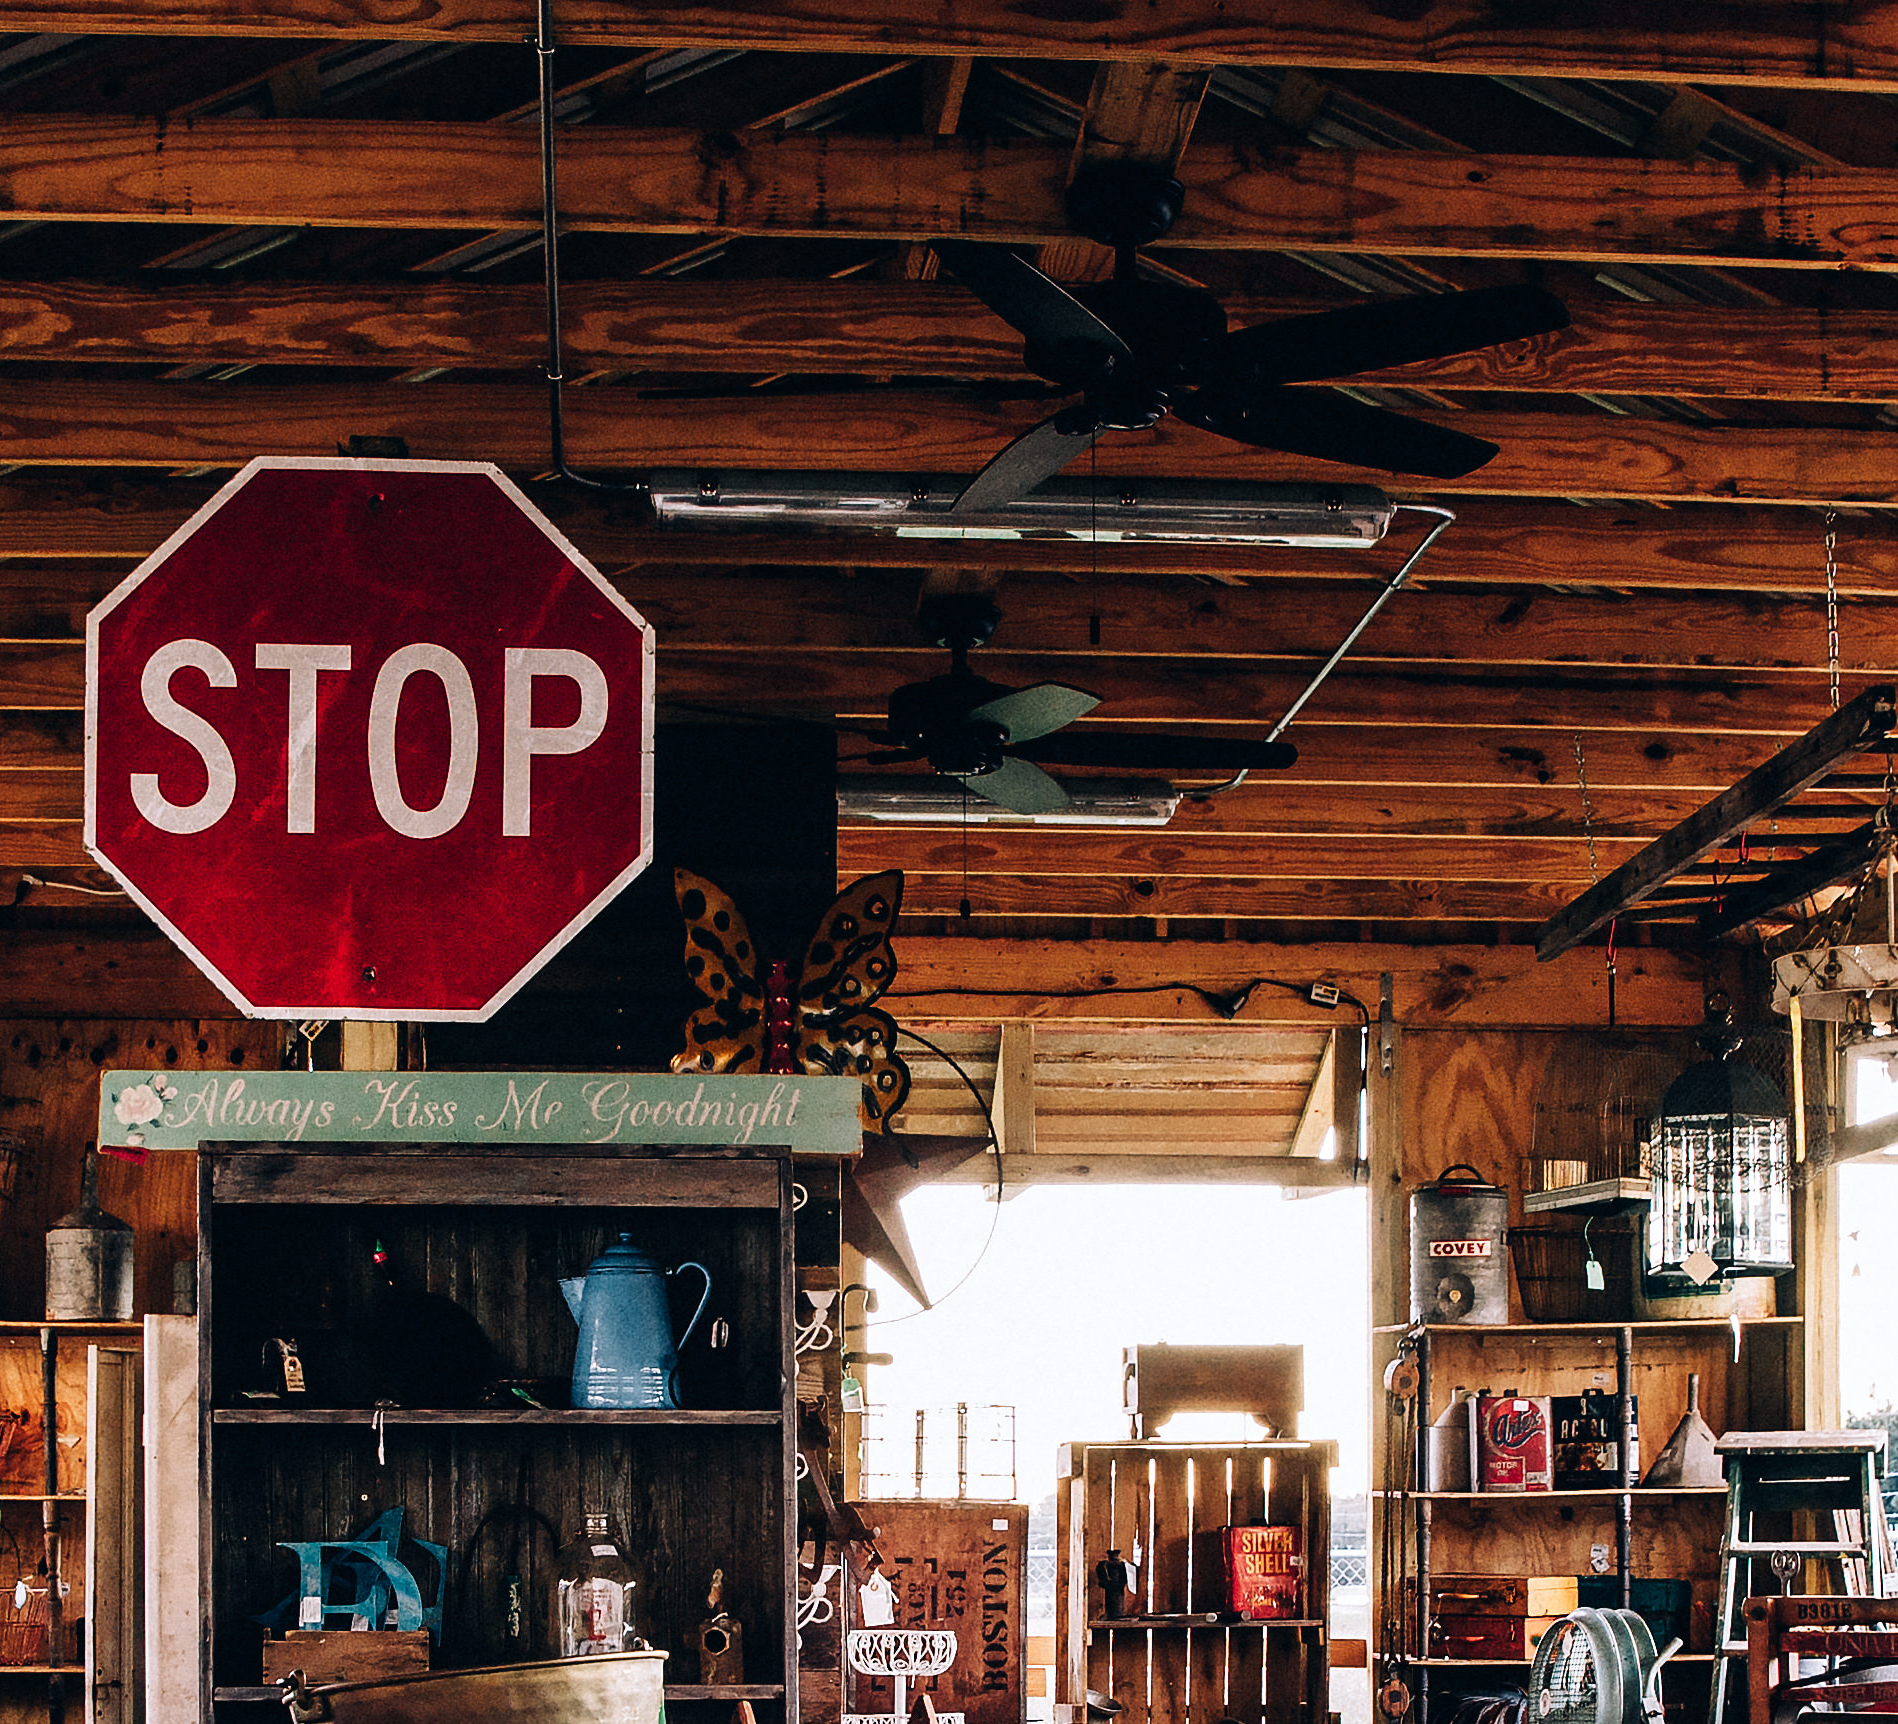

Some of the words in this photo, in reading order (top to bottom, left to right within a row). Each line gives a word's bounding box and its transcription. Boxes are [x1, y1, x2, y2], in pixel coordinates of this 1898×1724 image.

[130, 638, 609, 839] STOP
[165, 1078, 334, 1140] Always
[353, 1079, 459, 1131] Kiss
[475, 1079, 564, 1131] Me
[582, 1080, 804, 1143] Goodnight
[1433, 1242, 1486, 1255] COVEY
[1241, 1531, 1293, 1553] SILVER
[1245, 1553, 1290, 1574] SHELL
[981, 1539, 1009, 1692] BOSTON
